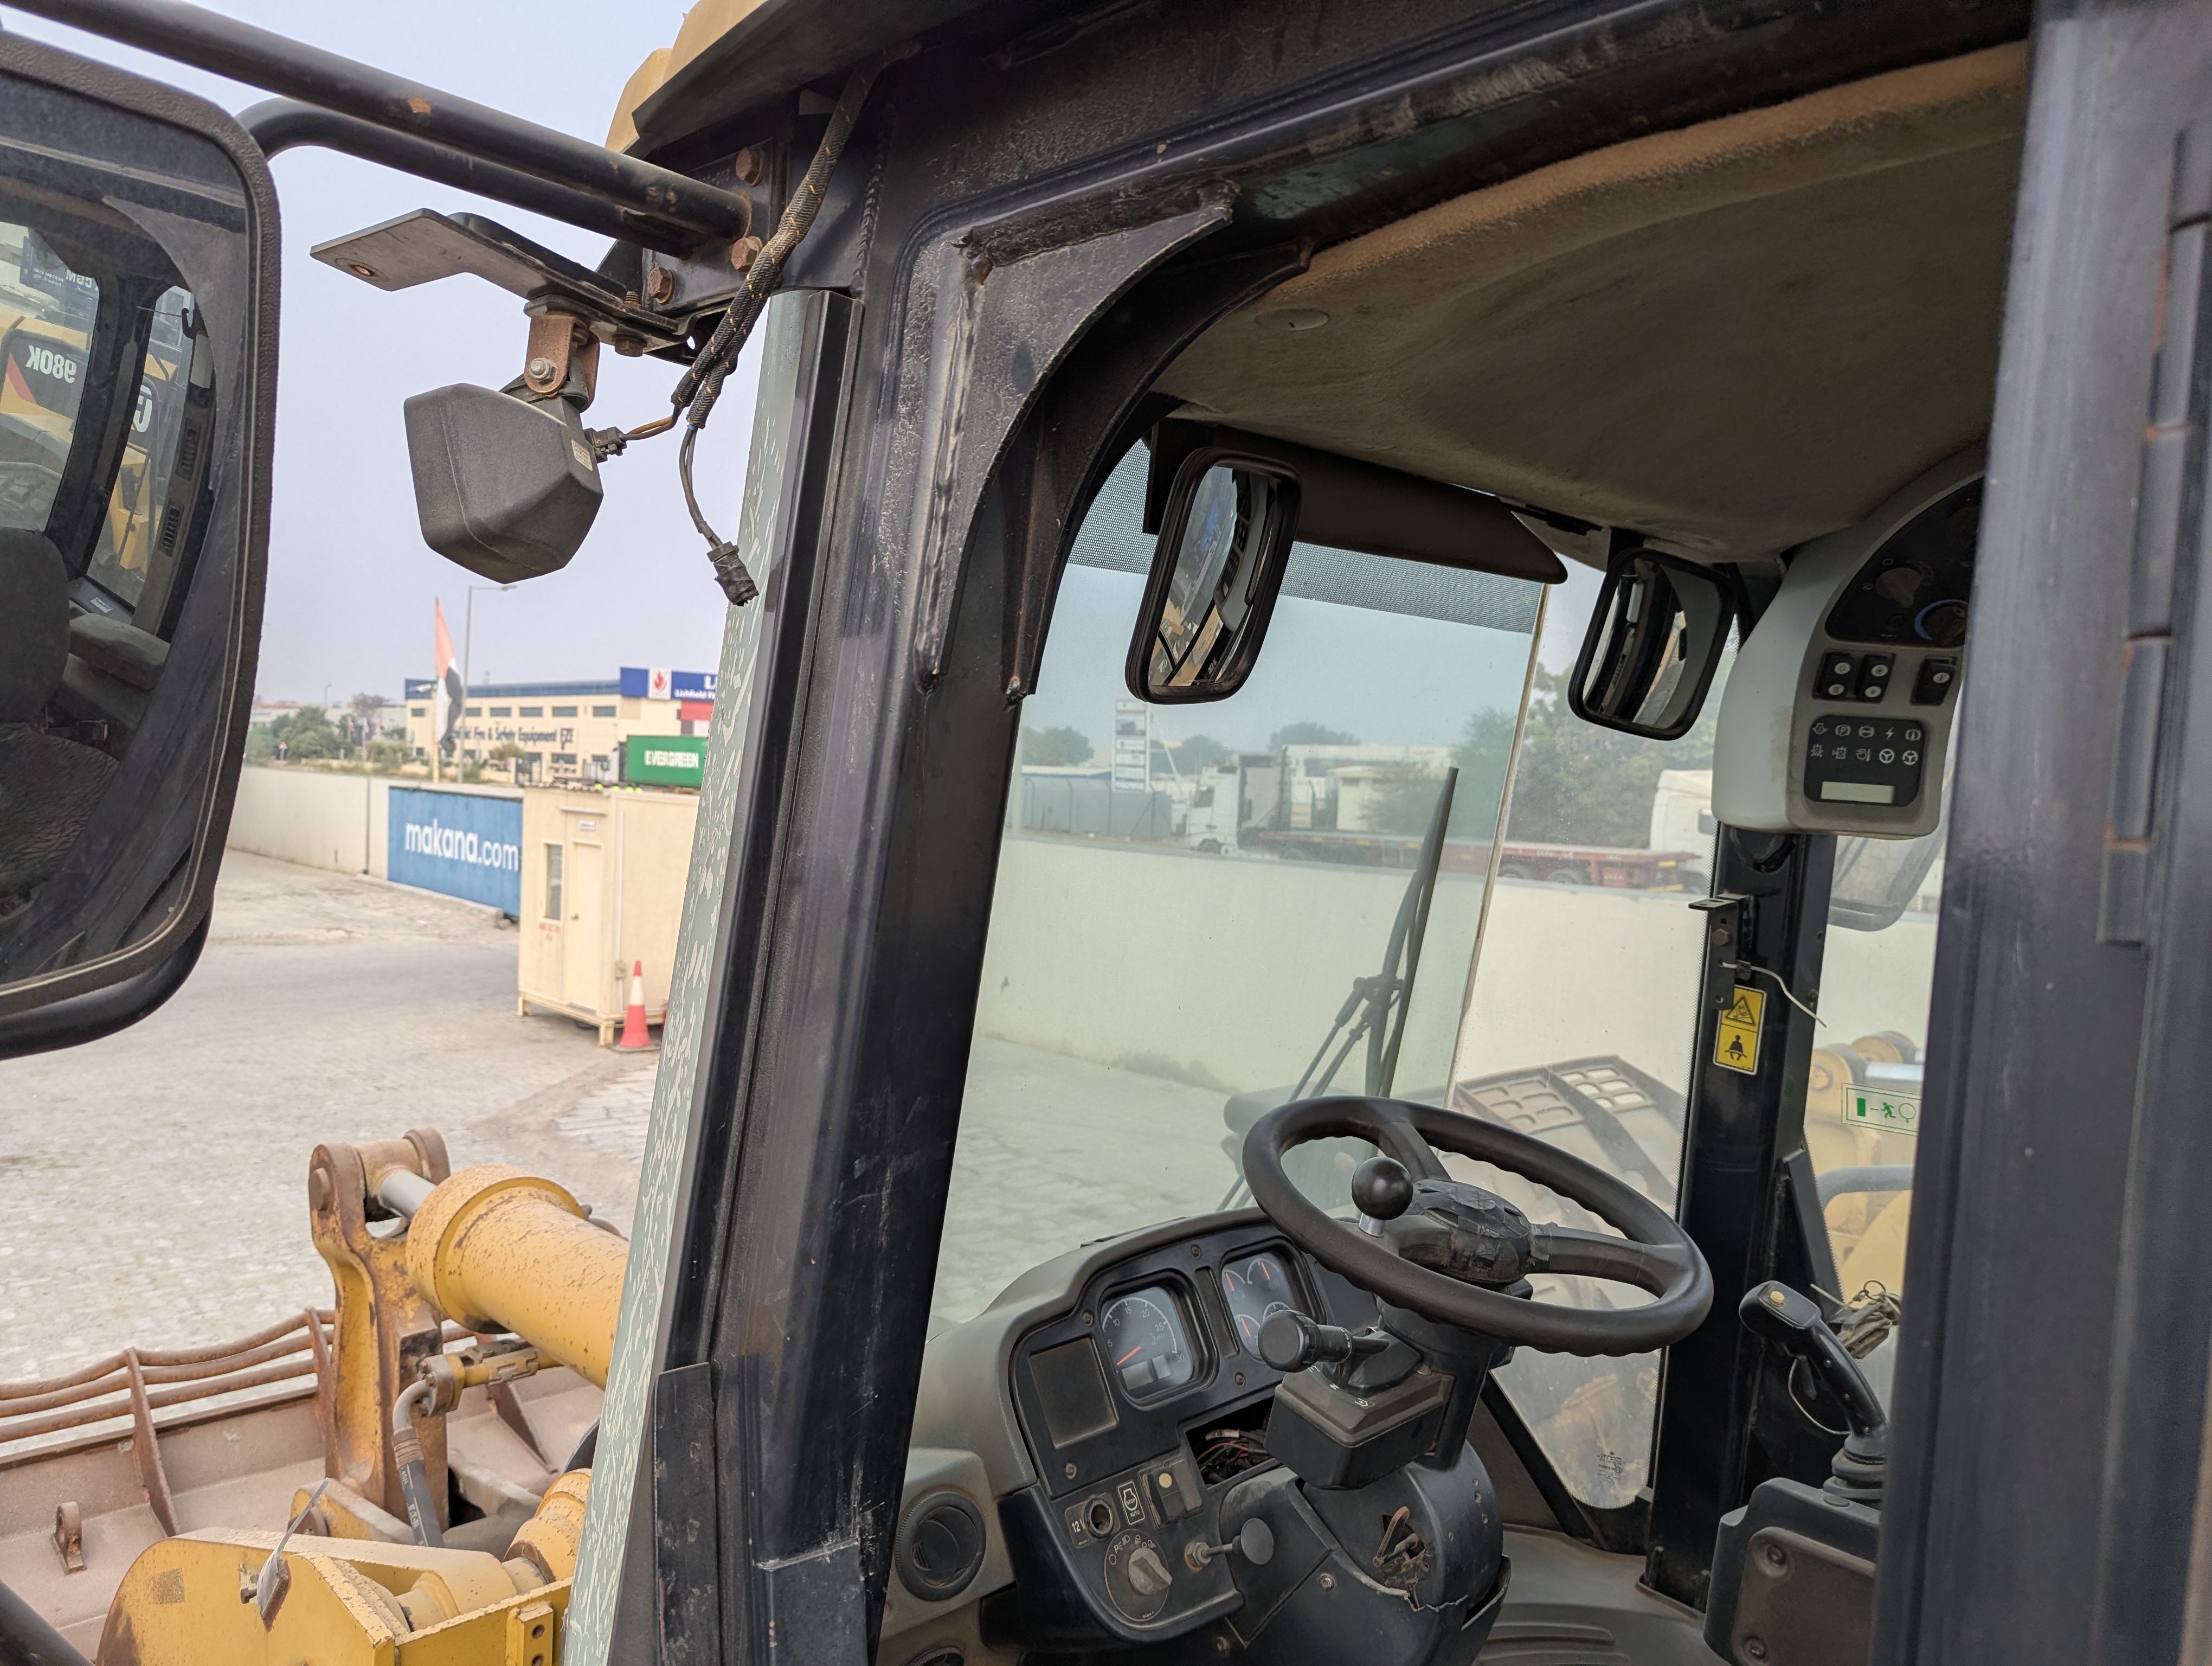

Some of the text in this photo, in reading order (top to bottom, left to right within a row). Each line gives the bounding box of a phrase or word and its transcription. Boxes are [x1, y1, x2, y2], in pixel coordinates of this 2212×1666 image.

[644, 749, 699, 769] EVERGREEN
[404, 818, 519, 872] makana.com
[1124, 1306, 1132, 1315] 15
[1141, 1309, 1150, 1318] 20
[1113, 1318, 1120, 1327] 10
[1155, 1323, 1163, 1332] 25
[1107, 1339, 1113, 1347] 5
[1176, 1354, 1185, 1362] 30
[1130, 1510, 1140, 1518] AUTO
[1071, 1521, 1081, 1533] 12
